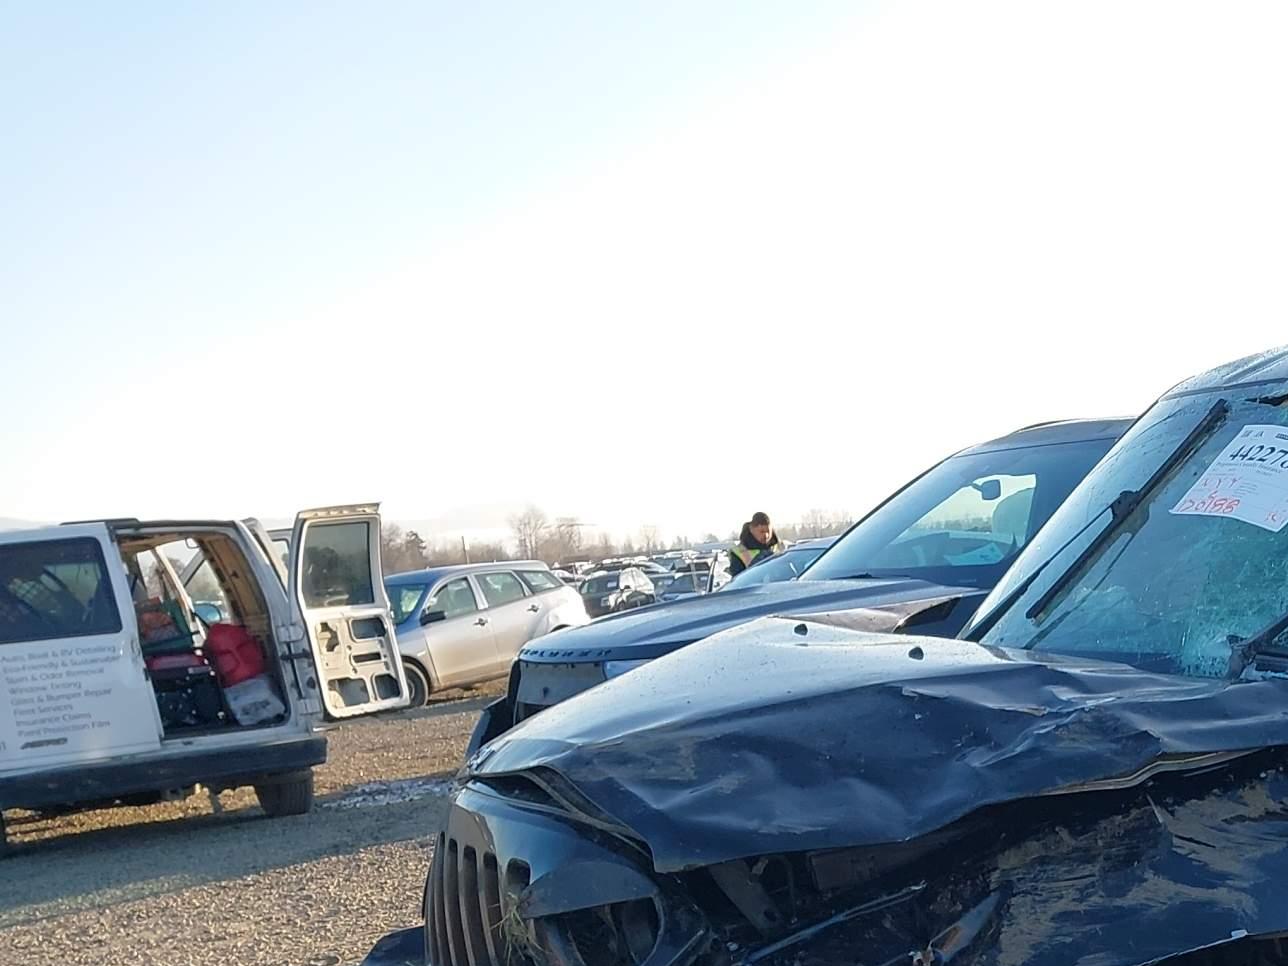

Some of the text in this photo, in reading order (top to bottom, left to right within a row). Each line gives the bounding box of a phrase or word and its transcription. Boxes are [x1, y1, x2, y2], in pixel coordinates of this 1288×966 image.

[60, 648, 73, 657] RV
[75, 646, 116, 657] Detailing
[83, 688, 112, 698] Repair
